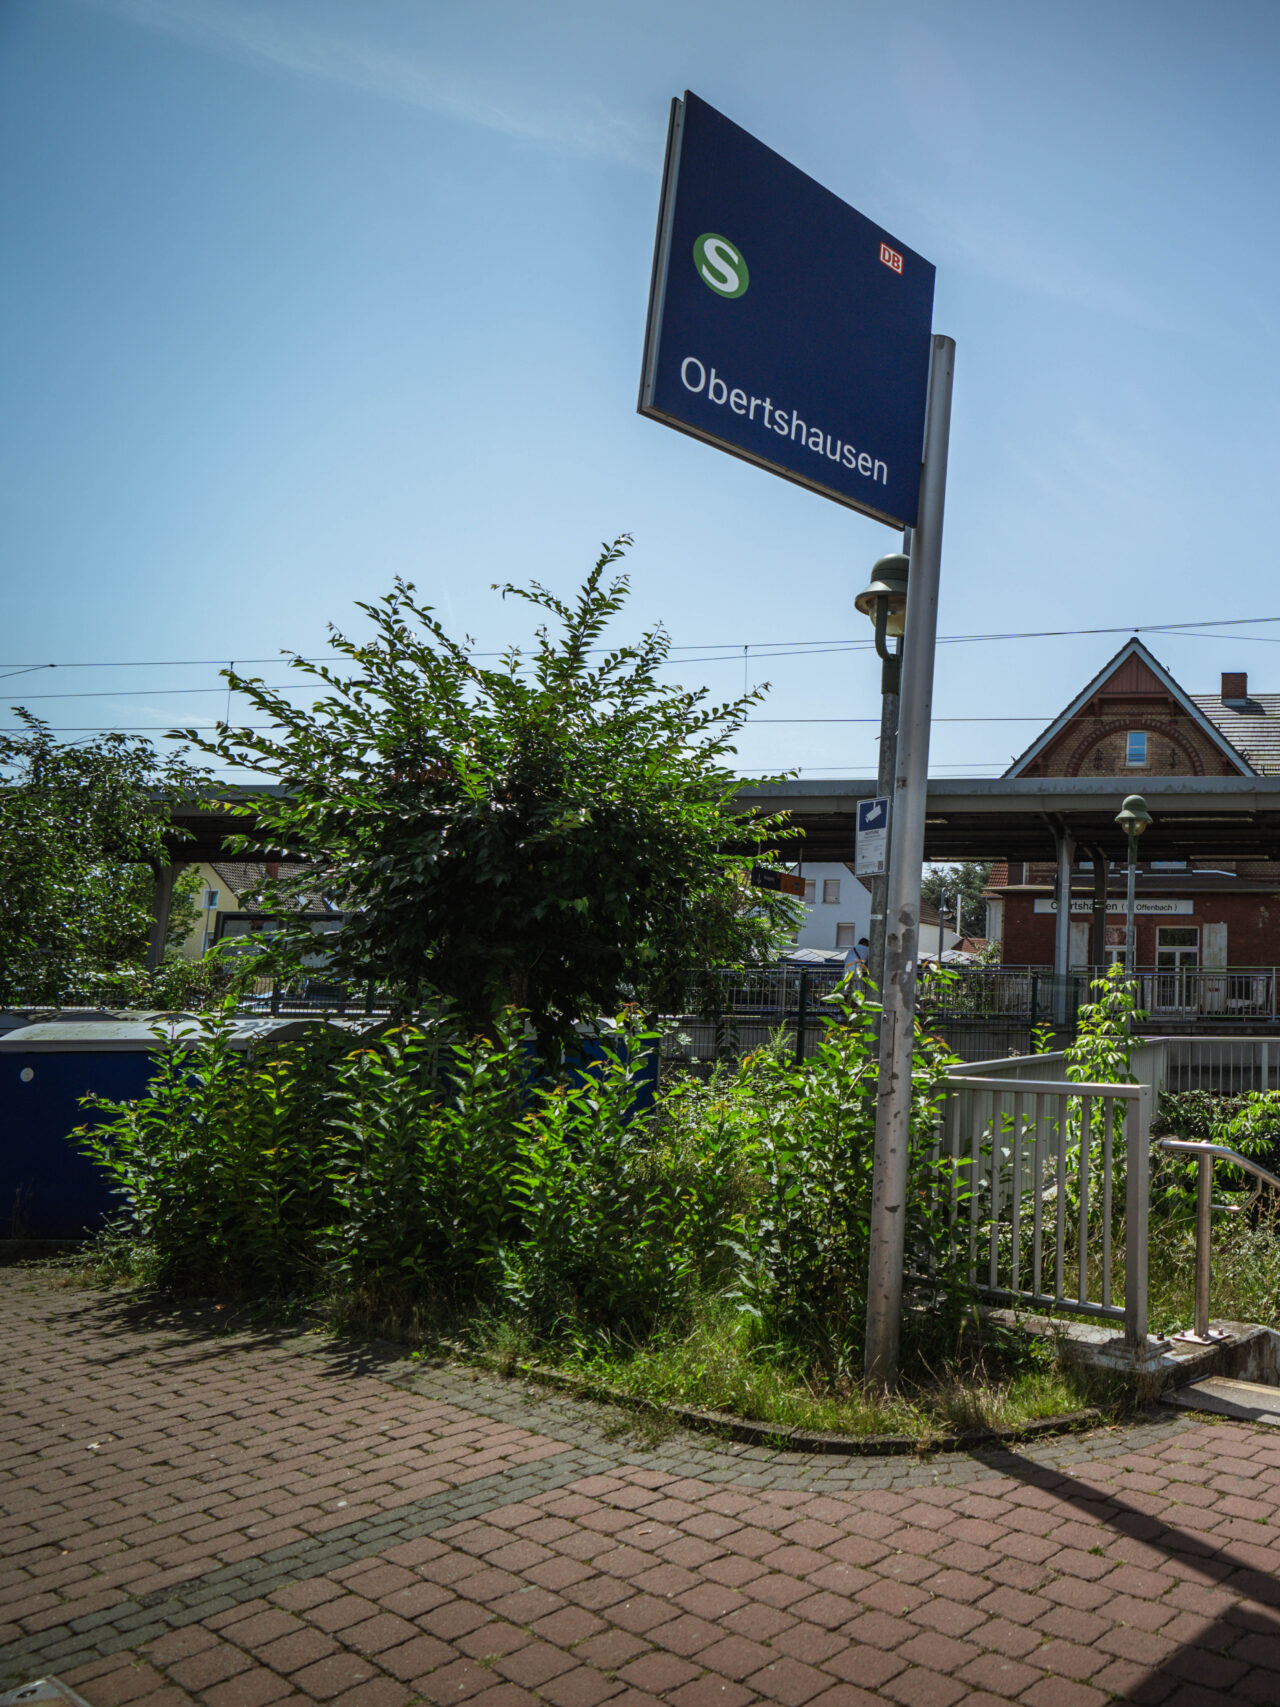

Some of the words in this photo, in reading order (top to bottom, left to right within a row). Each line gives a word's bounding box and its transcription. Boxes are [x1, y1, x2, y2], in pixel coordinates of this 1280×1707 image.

[702, 237, 740, 293] S
[882, 246, 901, 270] DB
[681, 356, 888, 485] Obertshausen
